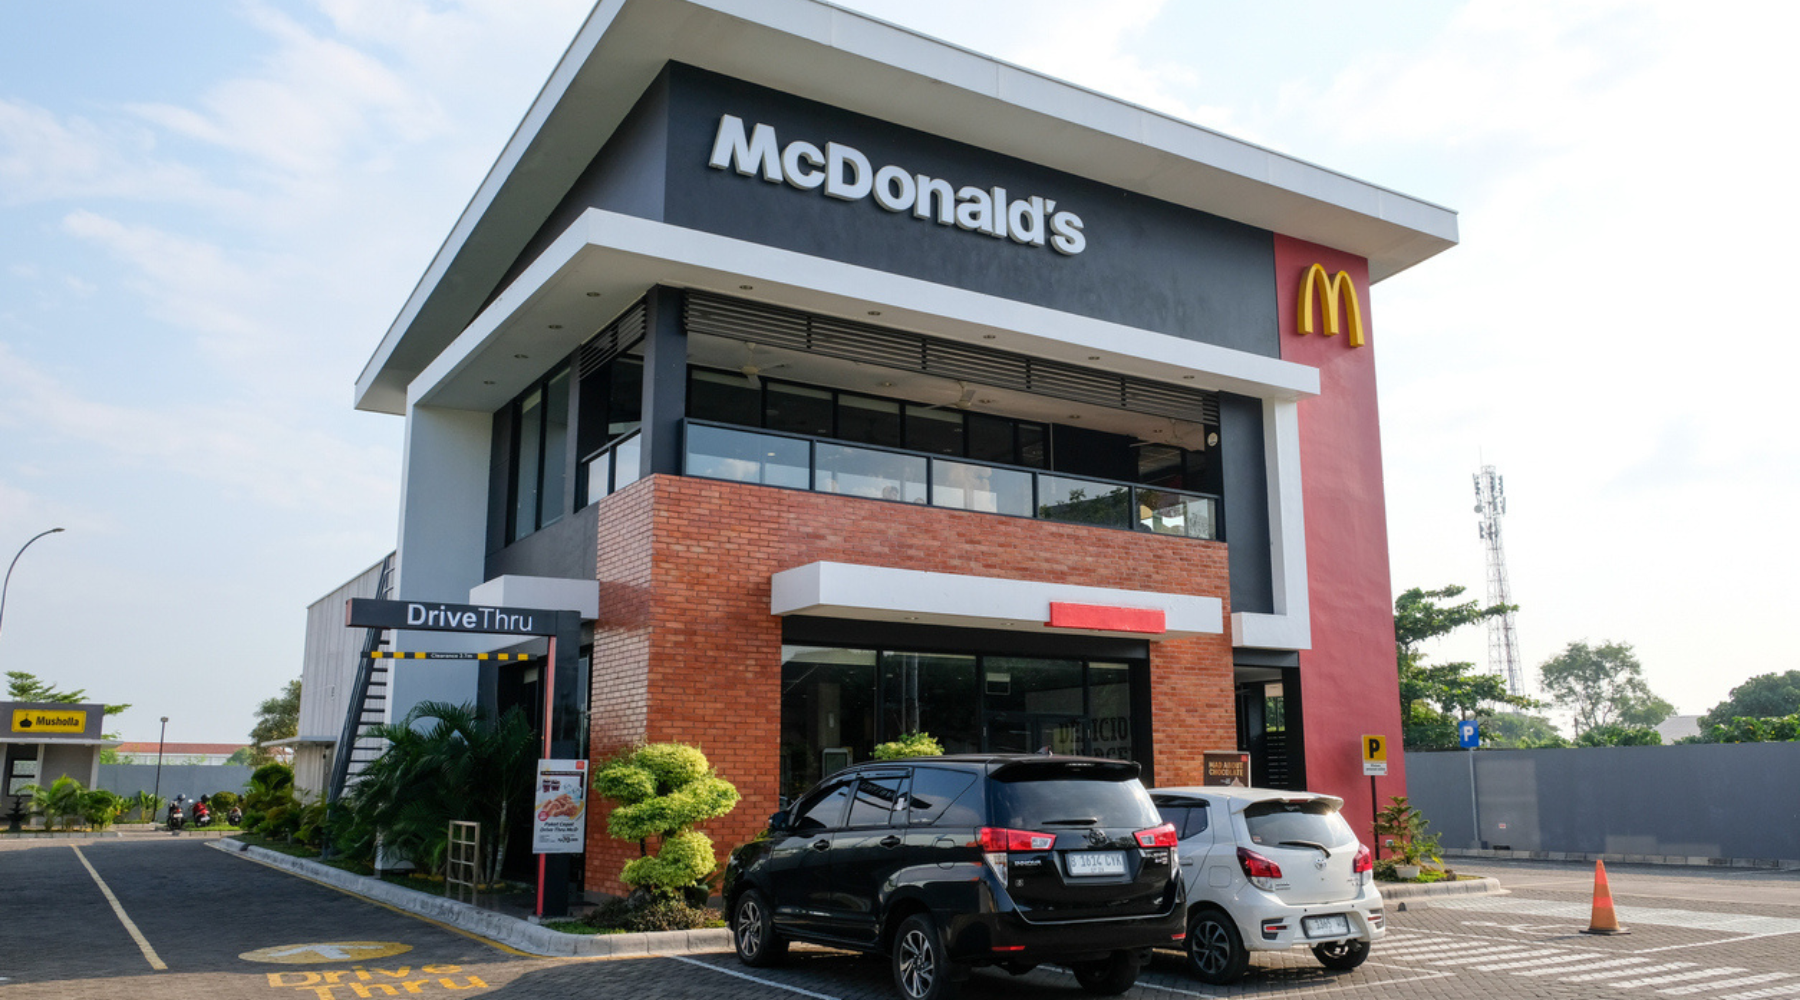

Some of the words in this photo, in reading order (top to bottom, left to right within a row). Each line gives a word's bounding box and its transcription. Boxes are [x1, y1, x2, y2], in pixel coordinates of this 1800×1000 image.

[708, 113, 1087, 256] McDonald's
[430, 652, 458, 660] Clearance
[36, 715, 79, 726] Musholla
[1463, 726, 1474, 742] P
[1368, 738, 1380, 759] P
[266, 963, 463, 988] Drive
[295, 975, 489, 1000] Thru
